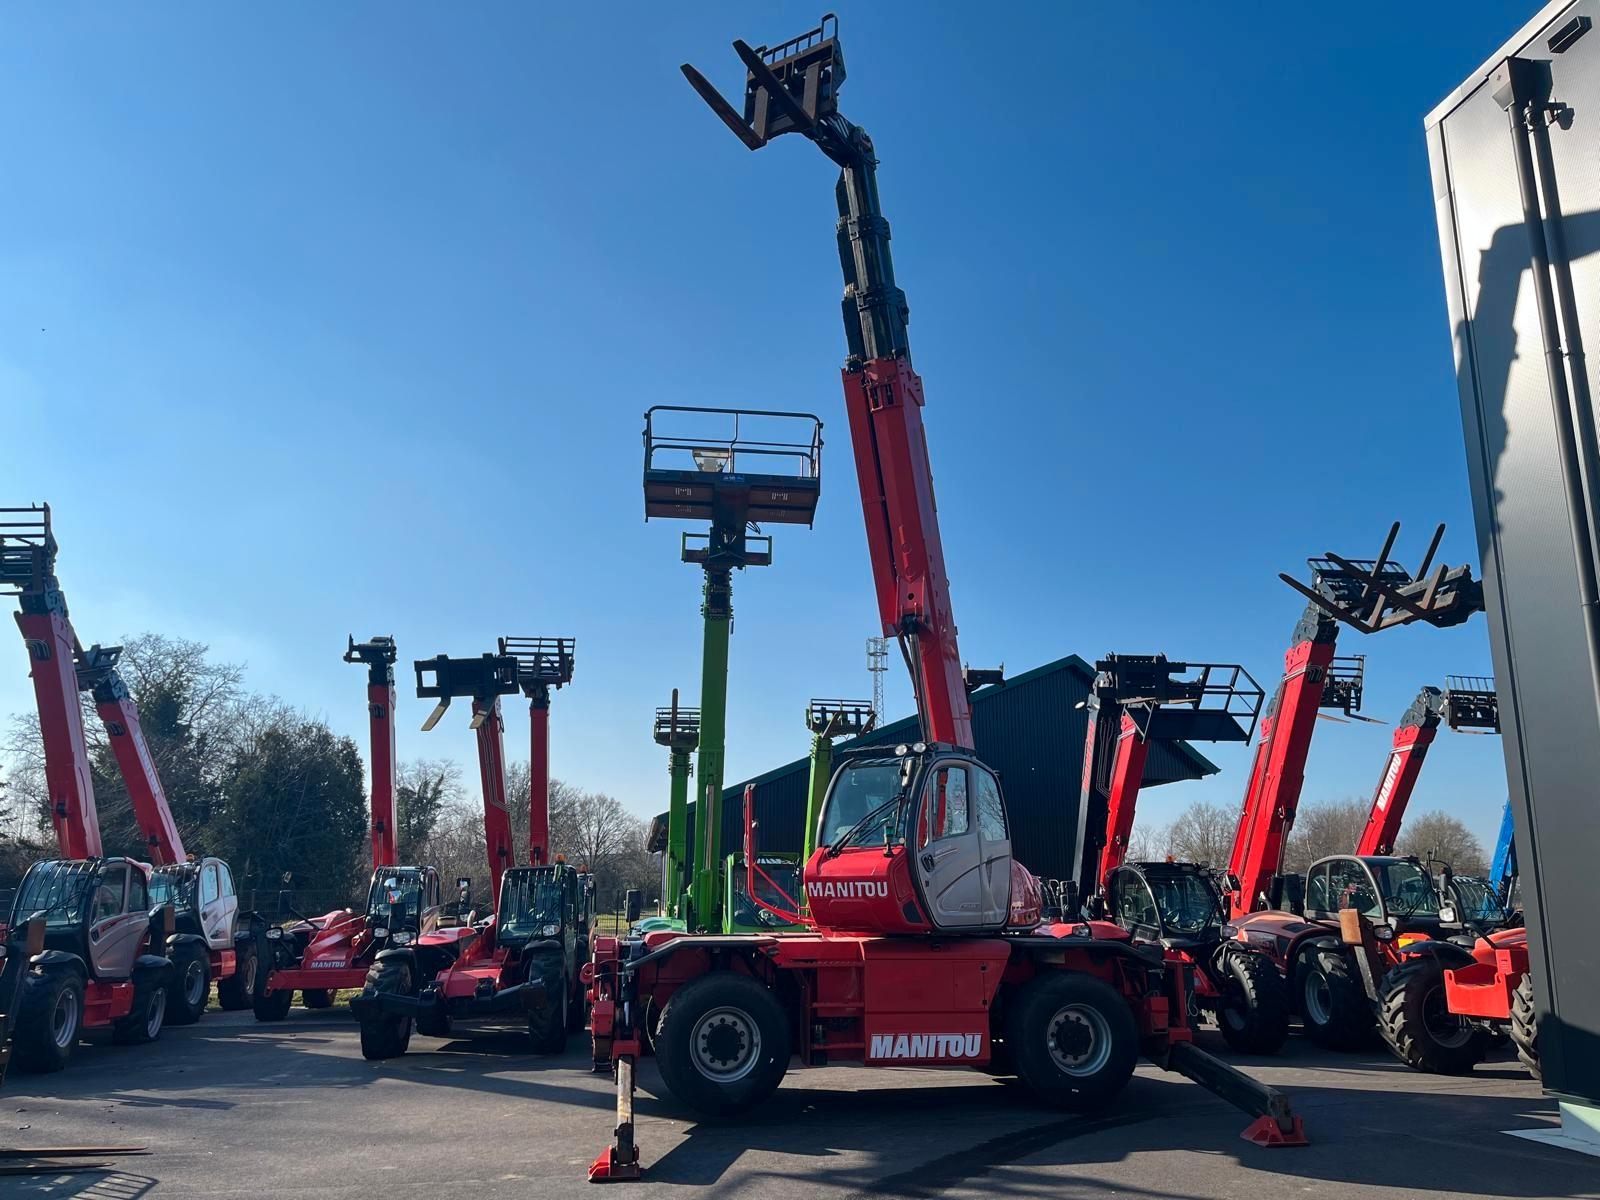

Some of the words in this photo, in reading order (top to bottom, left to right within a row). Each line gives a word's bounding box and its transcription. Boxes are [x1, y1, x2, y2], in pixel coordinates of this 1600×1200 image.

[1376, 753, 1402, 812] MANITOU
[807, 881, 889, 898] MANITOU
[311, 961, 346, 969] MANITOU
[869, 1033, 982, 1059] MANITOU
